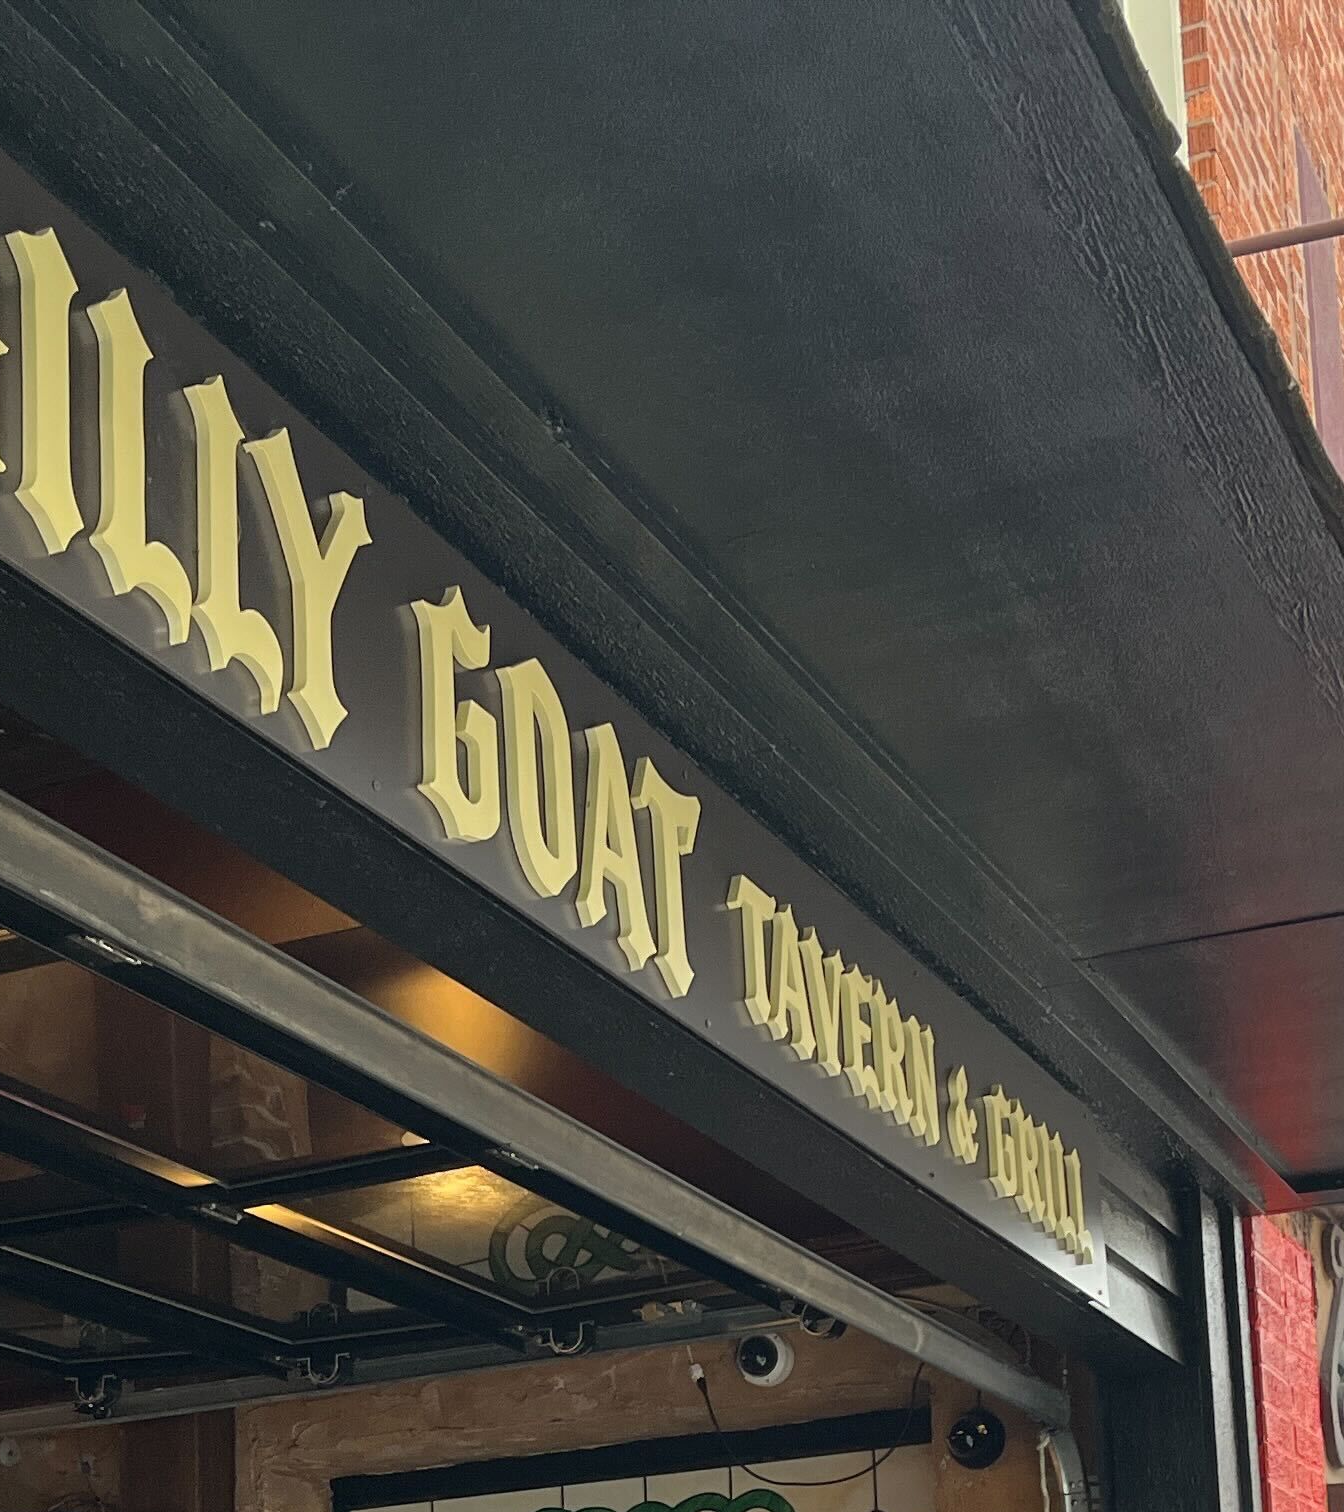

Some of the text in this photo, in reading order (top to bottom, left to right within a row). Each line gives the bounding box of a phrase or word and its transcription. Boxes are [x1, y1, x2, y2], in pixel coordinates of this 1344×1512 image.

[411, 585, 701, 999] GOAT
[726, 873, 941, 1147] TAVERN
[947, 1065, 979, 1165] &
[982, 1084, 1094, 1265] GRILL
